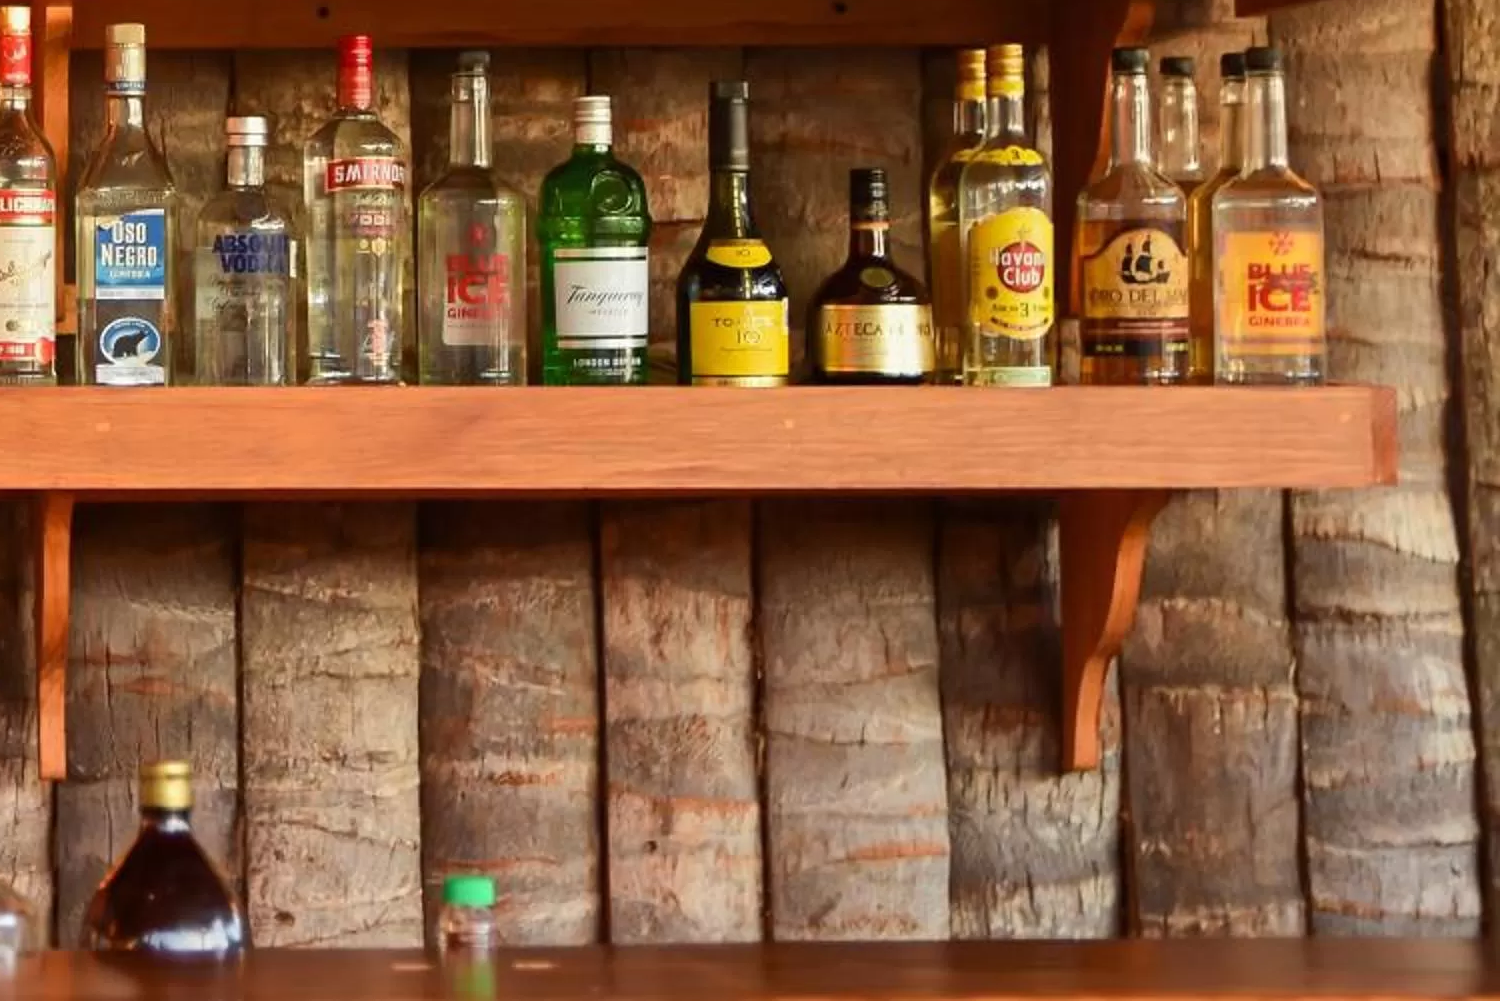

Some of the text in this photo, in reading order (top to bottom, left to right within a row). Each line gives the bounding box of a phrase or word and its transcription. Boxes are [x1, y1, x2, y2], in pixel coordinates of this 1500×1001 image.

[101, 243, 157, 267] NEGRO
[1003, 266, 1041, 286] Club
[1247, 283, 1312, 312] ICE
[826, 322, 884, 336] AZTECA
